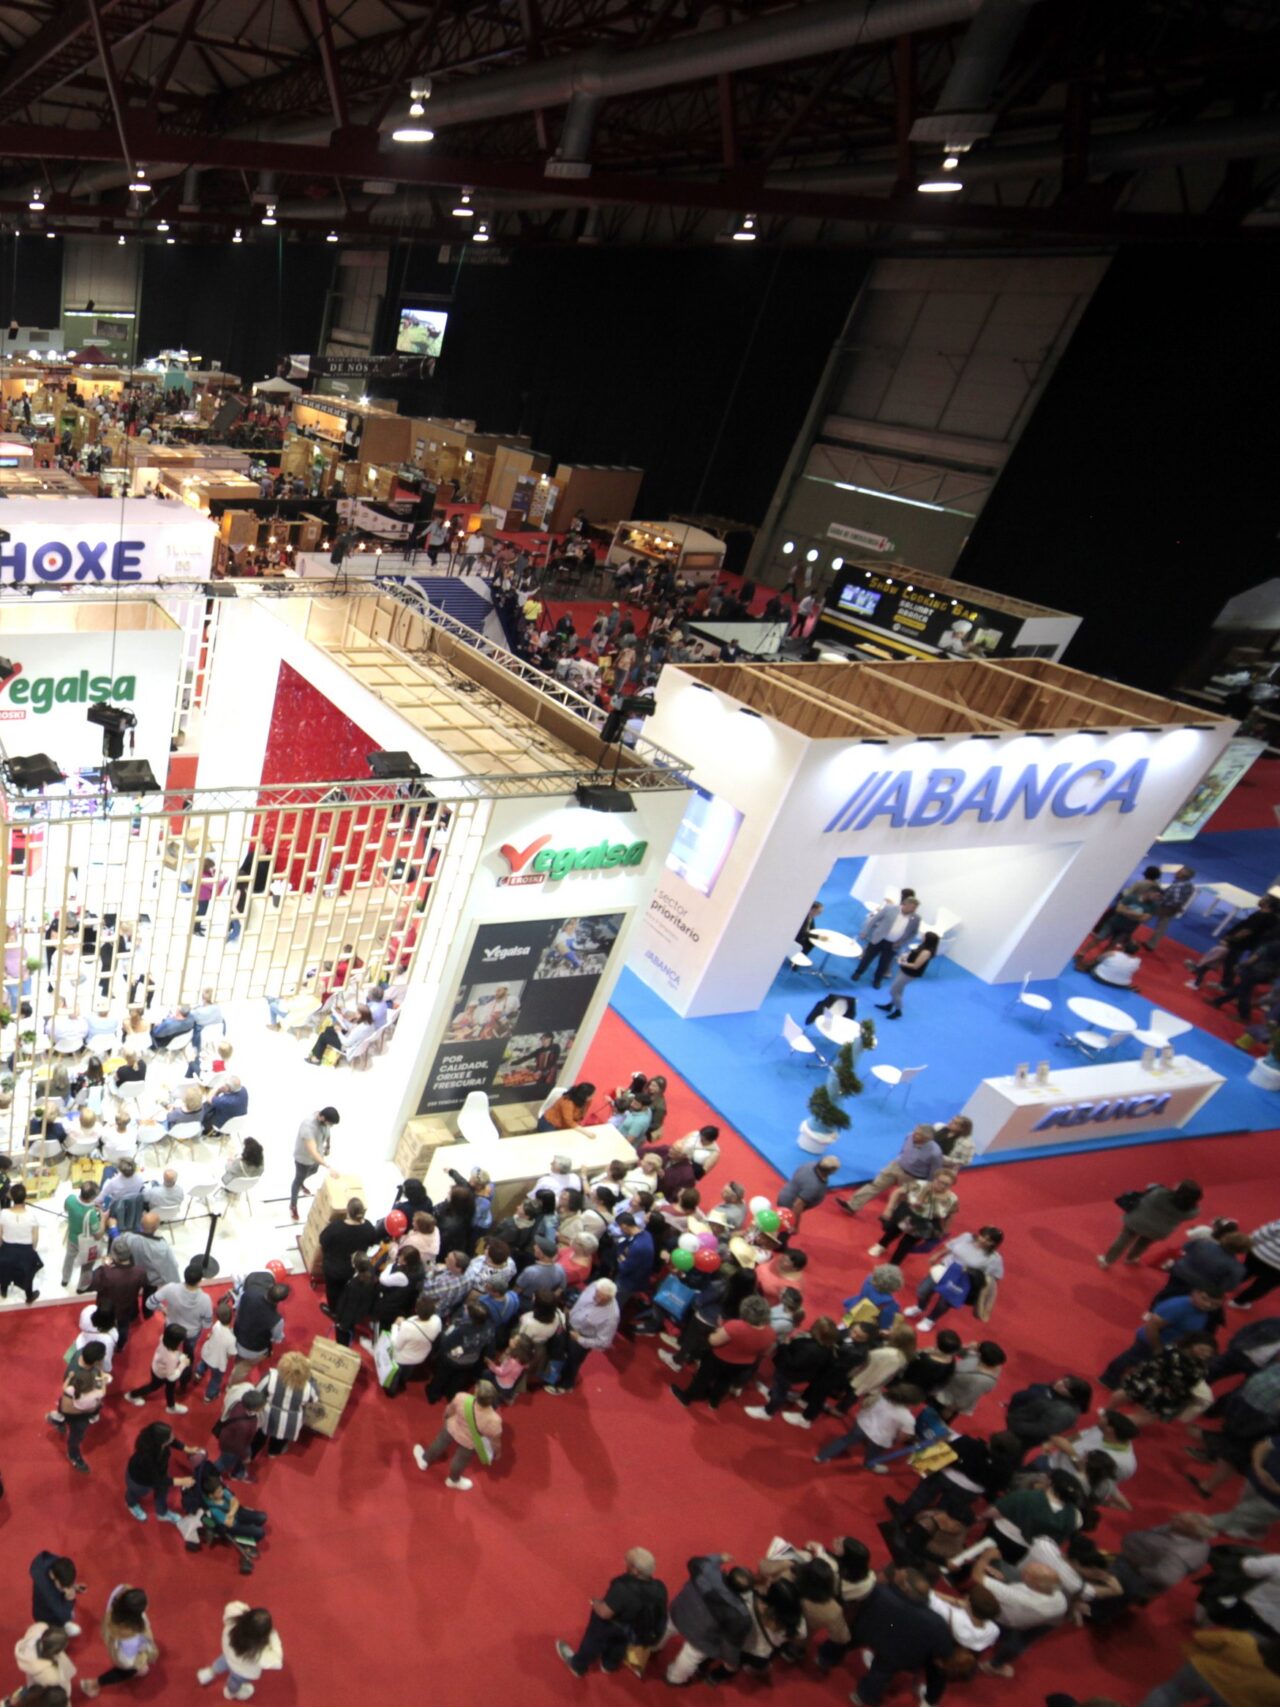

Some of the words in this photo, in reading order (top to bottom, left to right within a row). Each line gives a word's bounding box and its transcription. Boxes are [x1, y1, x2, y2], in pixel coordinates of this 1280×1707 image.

[500, 833, 648, 881] Vegalsa
[658, 890, 688, 917] sector
[650, 899, 700, 943] prioritario
[484, 944, 532, 960] Vegalsa
[439, 1060, 489, 1073] CALIDADE,
[441, 1055, 464, 1064] POR
[432, 1077, 487, 1090] FRESCURA!
[436, 1071, 466, 1082] ORIXE
